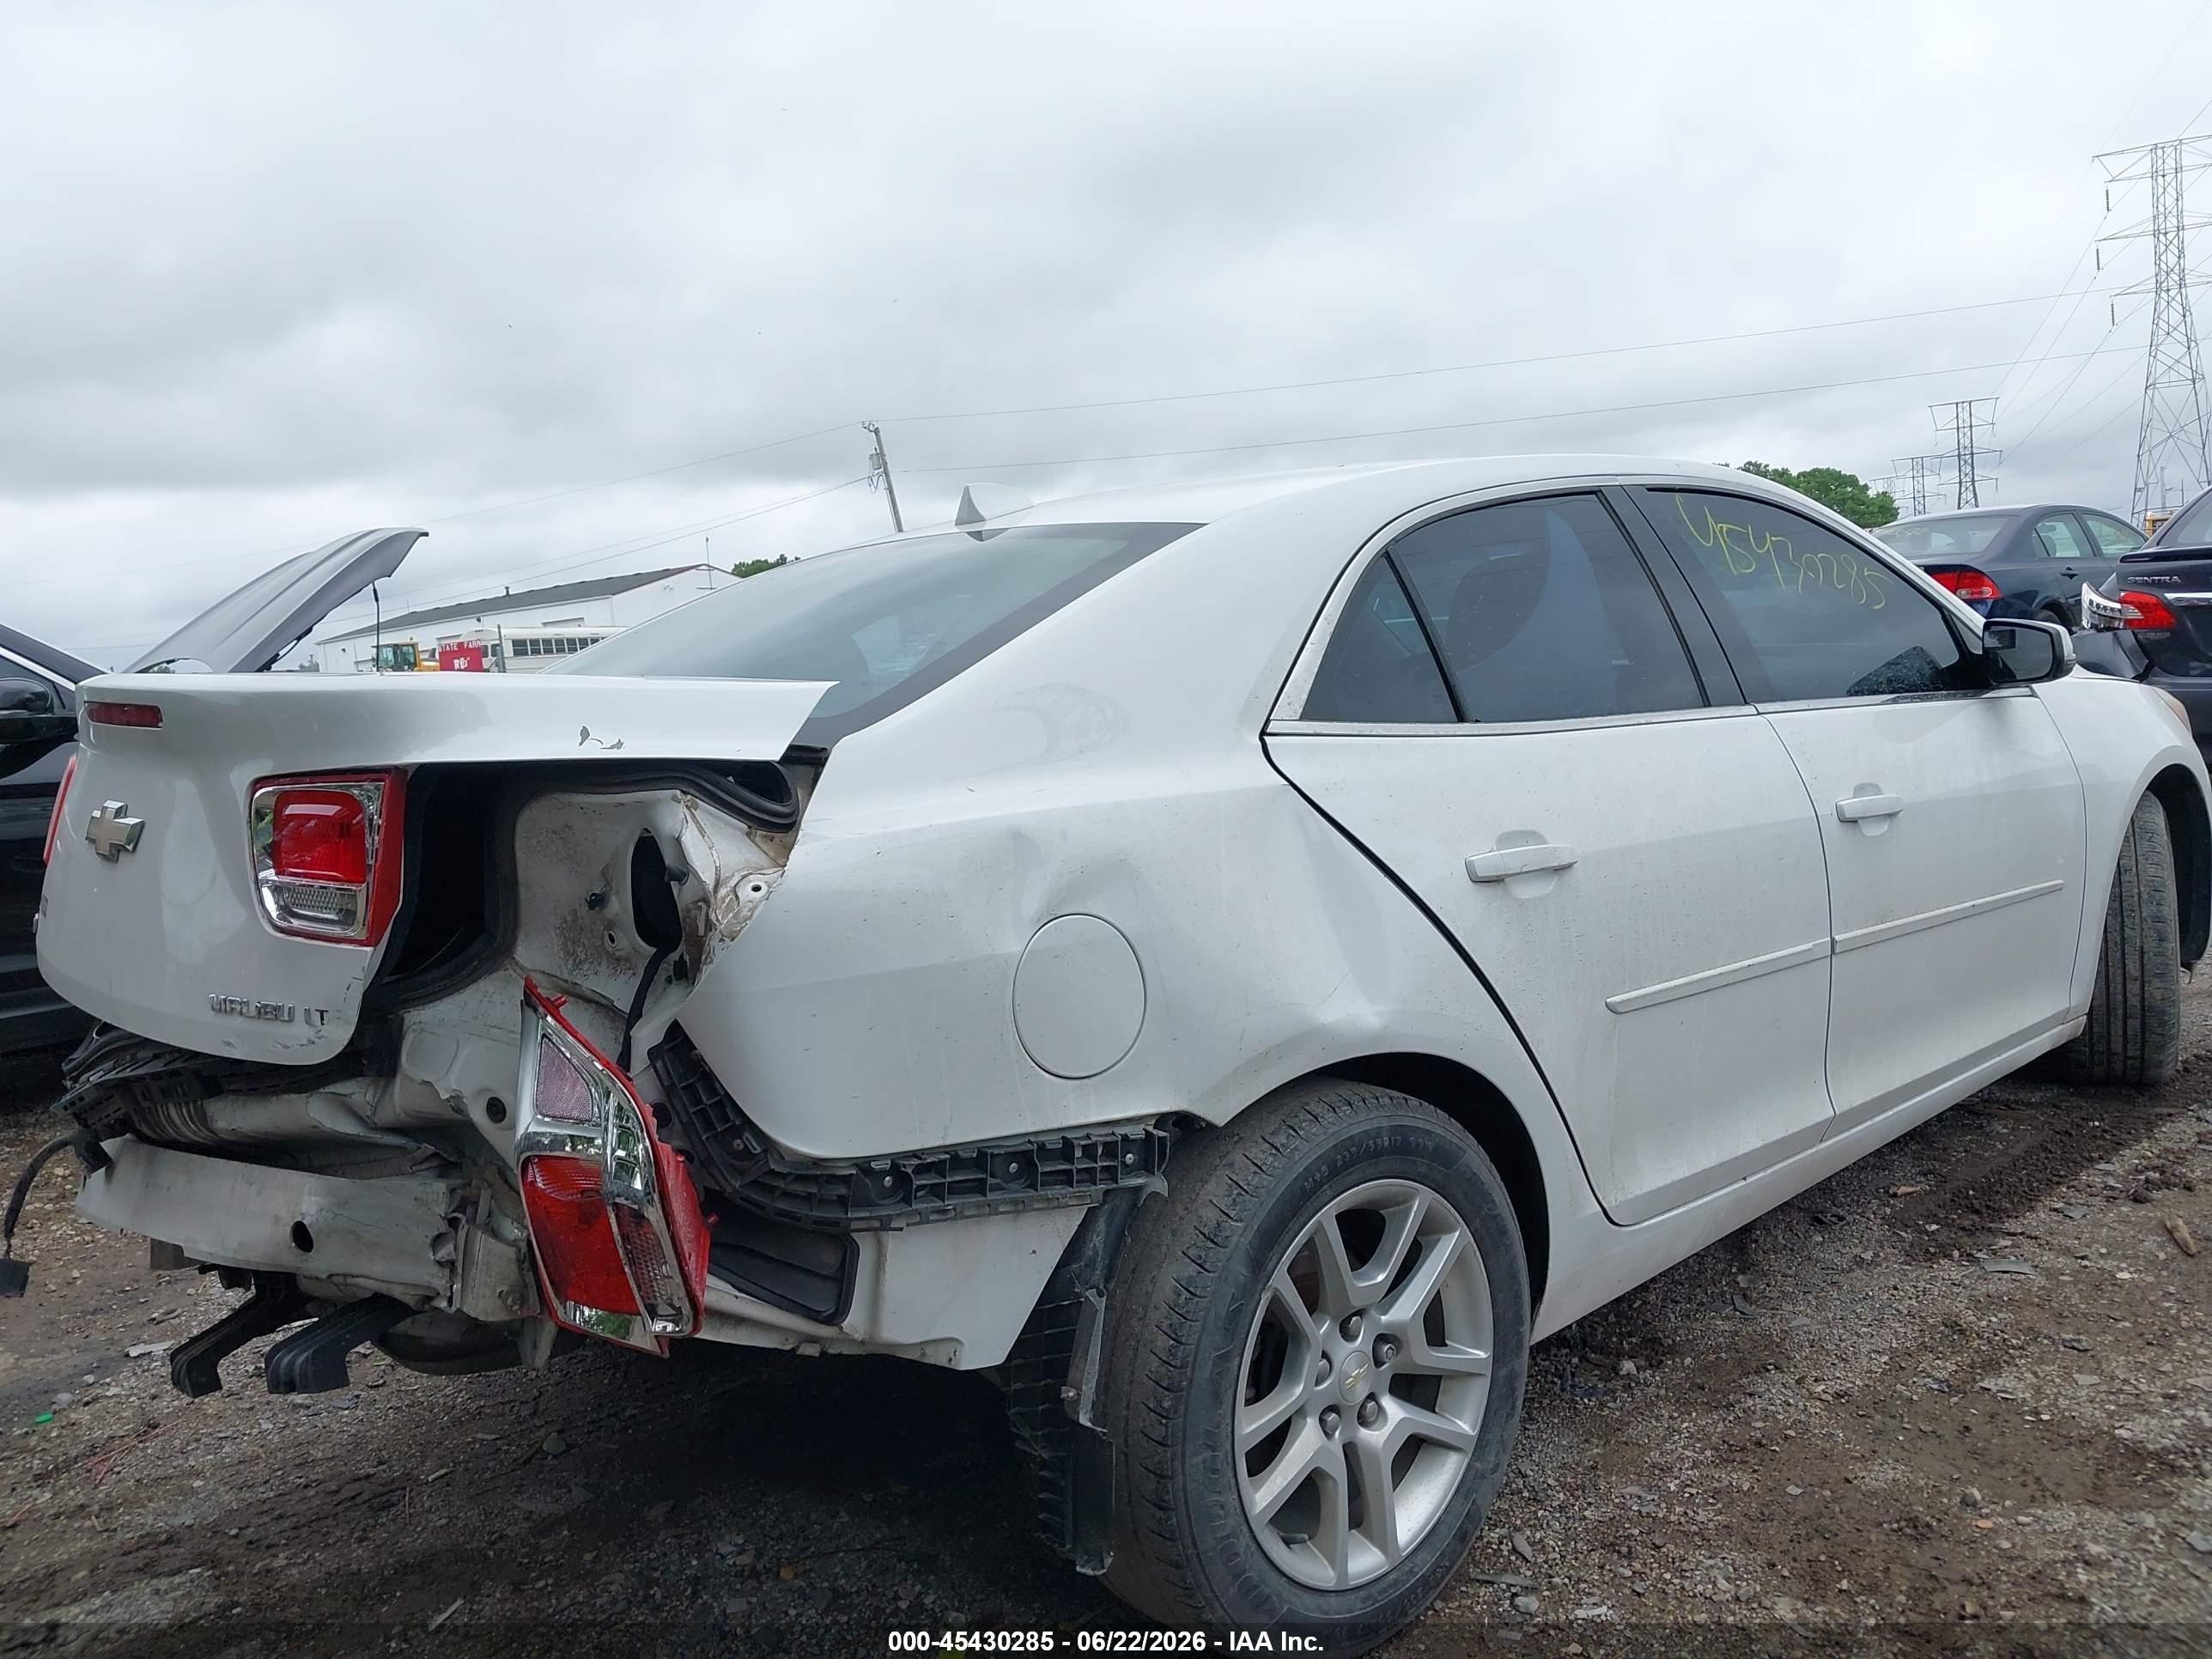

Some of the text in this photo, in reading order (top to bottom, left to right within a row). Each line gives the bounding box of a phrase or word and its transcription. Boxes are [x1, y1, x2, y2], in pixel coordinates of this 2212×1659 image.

[439, 642, 459, 653] STATE
[209, 994, 330, 1028] MALIBU LT
